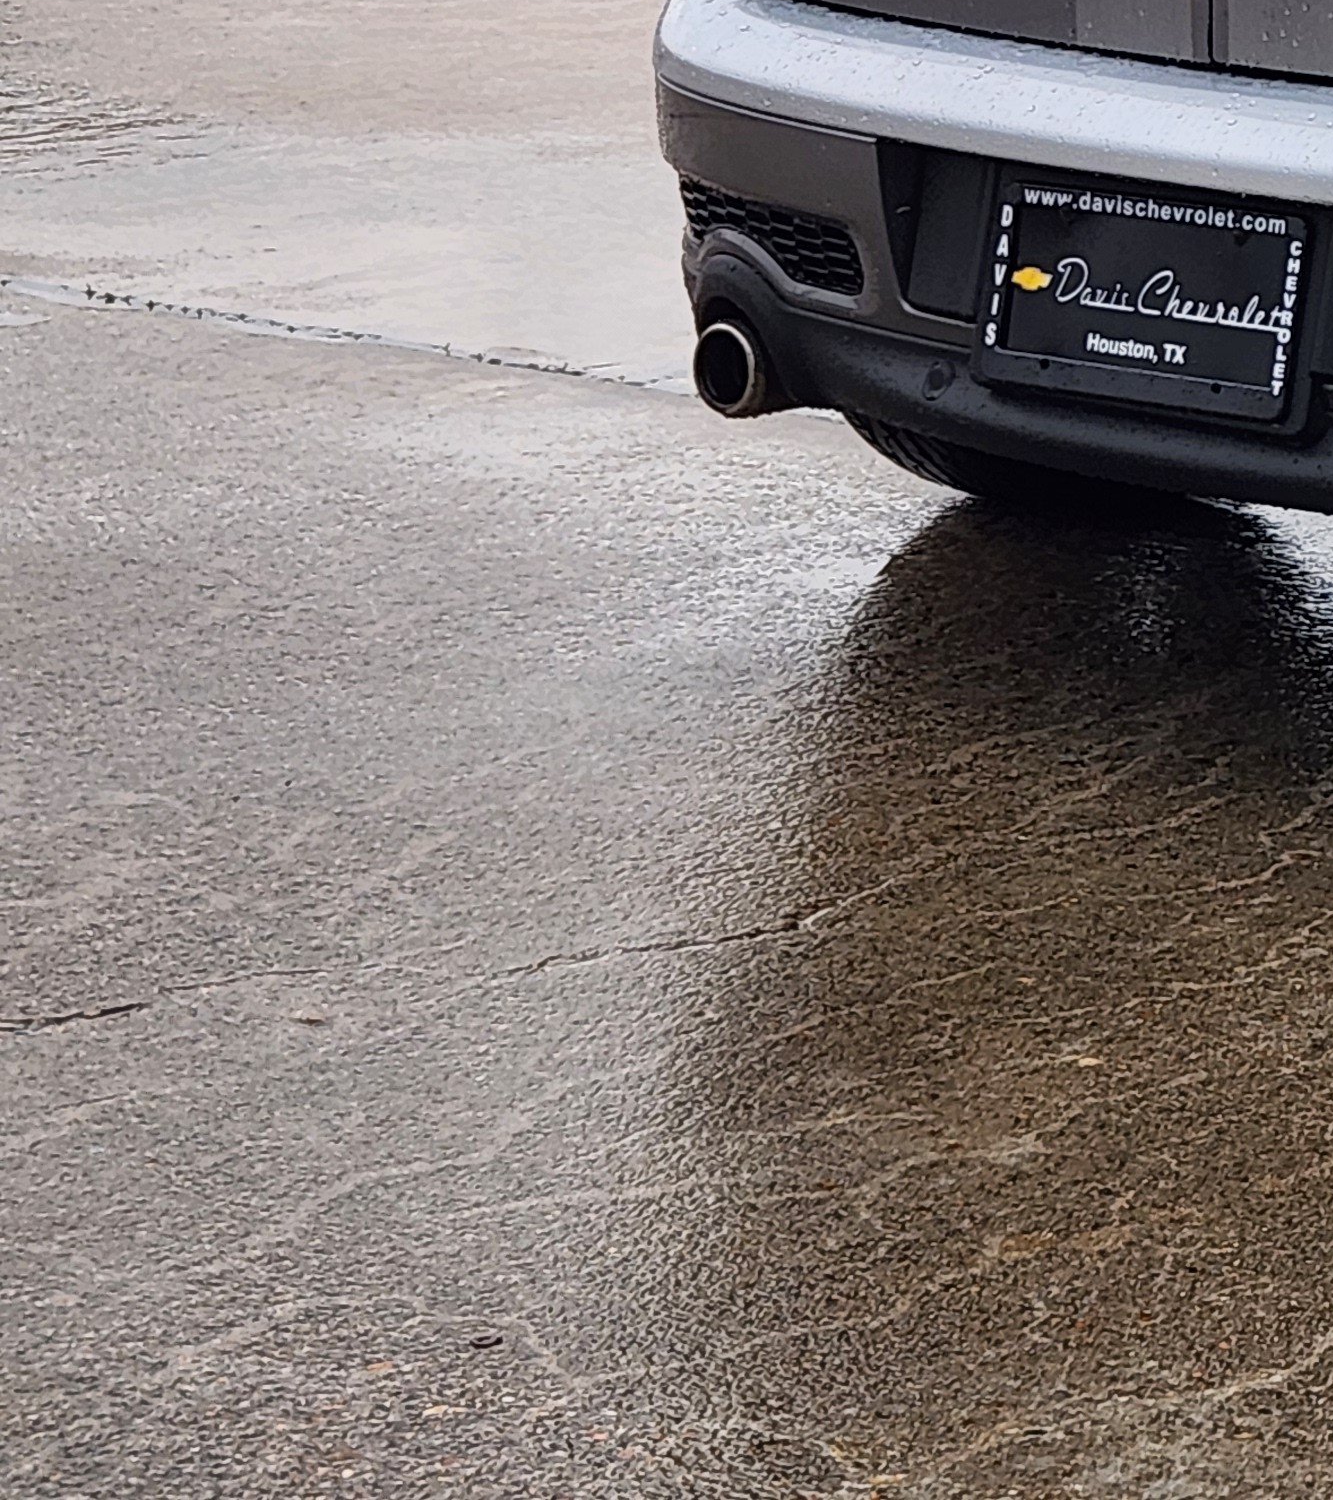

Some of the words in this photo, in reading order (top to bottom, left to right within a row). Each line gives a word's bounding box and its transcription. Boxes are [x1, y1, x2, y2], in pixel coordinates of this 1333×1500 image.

[1024, 187, 1287, 235] www.davischevrolet.com
[984, 204, 1014, 347] DAVIS
[1054, 256, 1136, 312] Davis
[1137, 269, 1283, 333] Chevrolet
[1086, 332, 1158, 365] Houston,
[1162, 342, 1188, 366] TX
[1271, 240, 1303, 396] CHEVROLET
